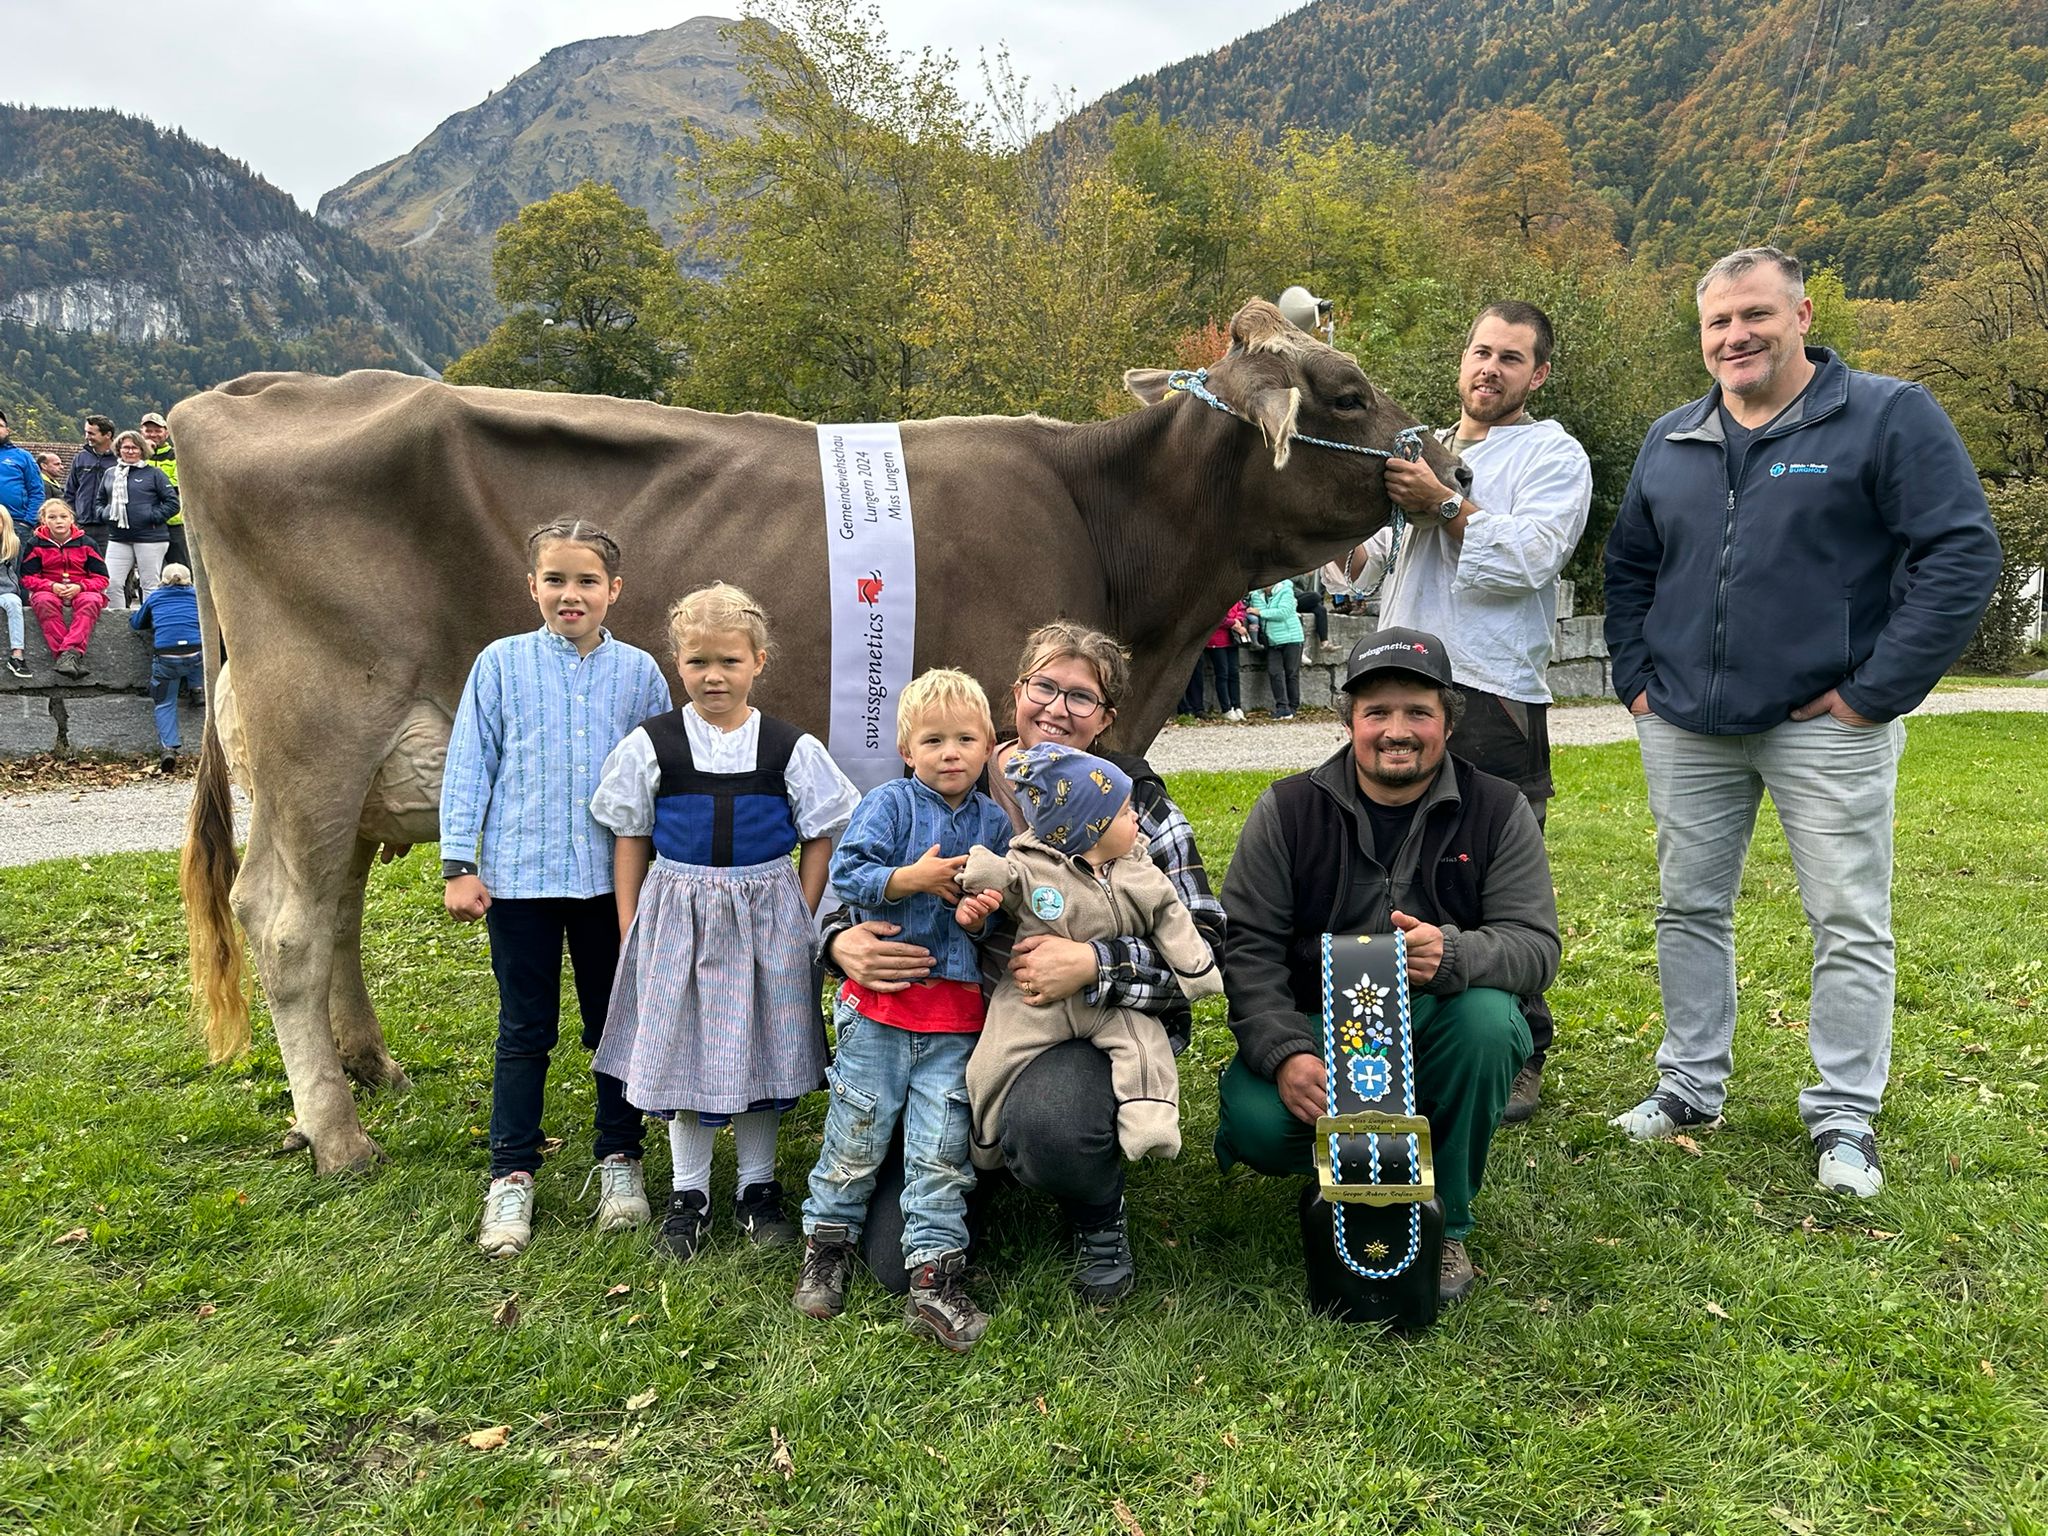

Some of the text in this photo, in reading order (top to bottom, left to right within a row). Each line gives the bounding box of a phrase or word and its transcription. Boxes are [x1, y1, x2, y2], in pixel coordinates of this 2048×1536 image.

[832, 435, 854, 540] Gemeindeviehschau
[856, 451, 879, 523] Lungern 2024
[883, 451, 902, 521] Miss Lungern
[861, 613, 888, 750] swissgenetics
[1358, 642, 1411, 660] swissgenetics
